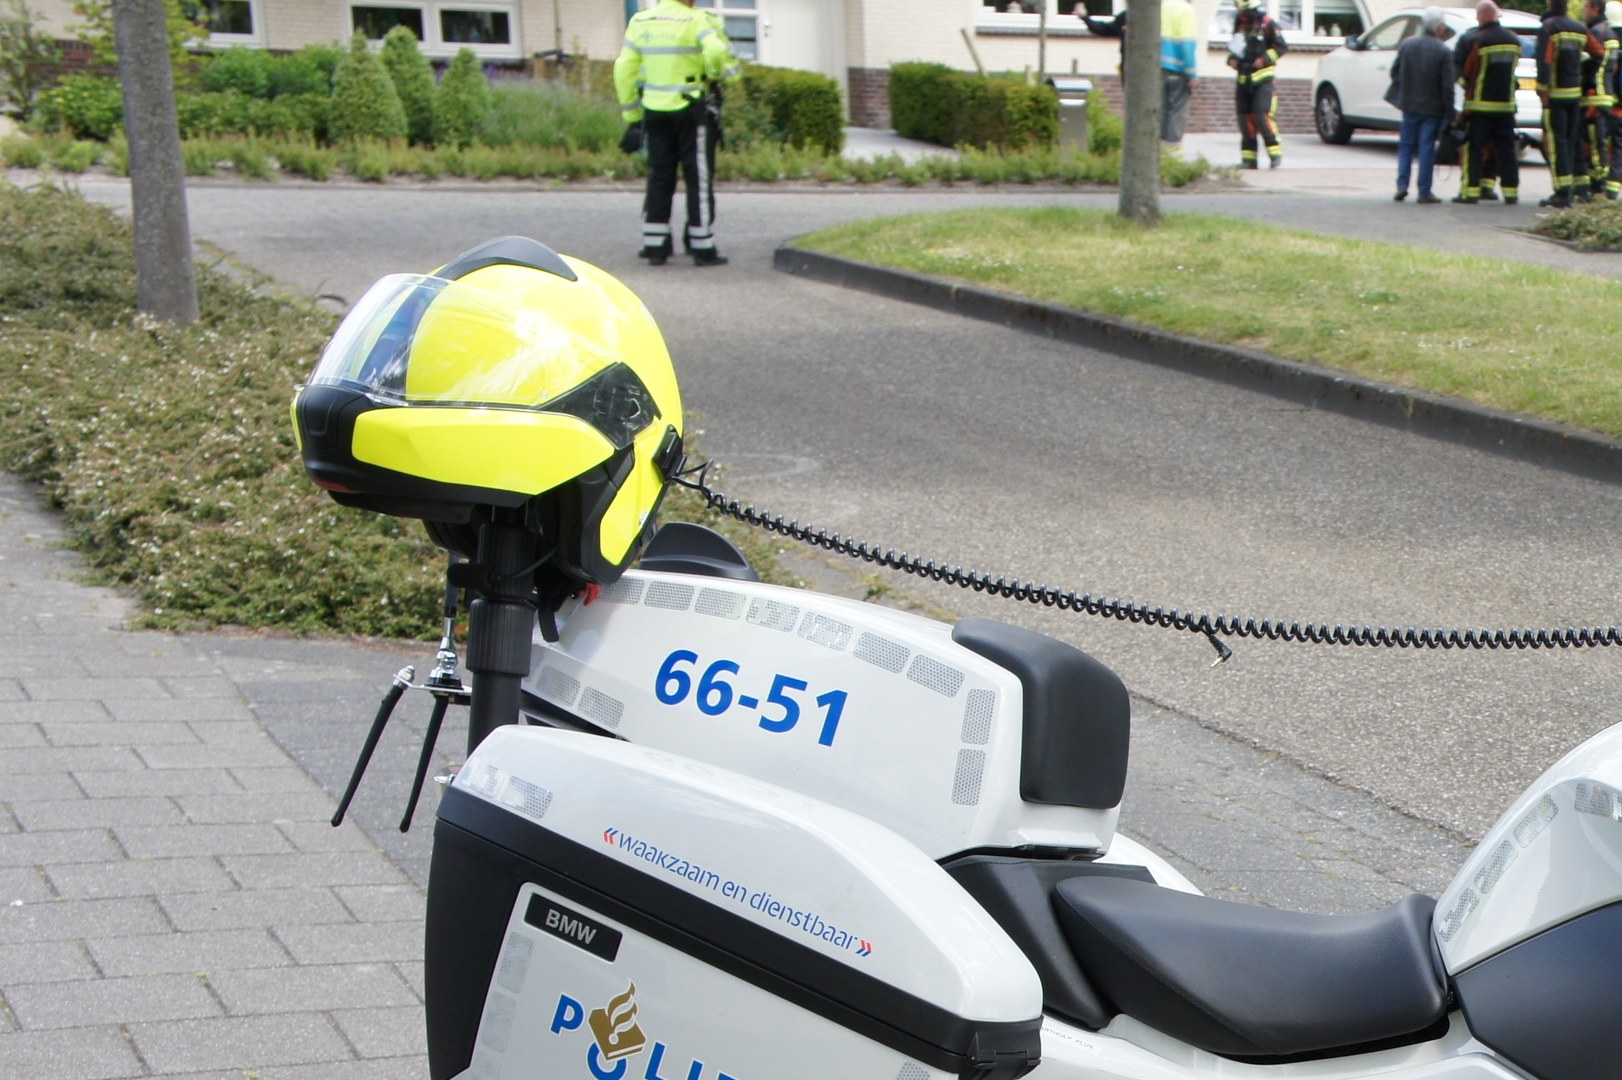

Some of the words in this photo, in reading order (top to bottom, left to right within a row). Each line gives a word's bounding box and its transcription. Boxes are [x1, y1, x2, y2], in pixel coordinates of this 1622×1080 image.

[653, 649, 849, 748] 66-51
[721, 880, 747, 902] en
[545, 909, 598, 946] BMW
